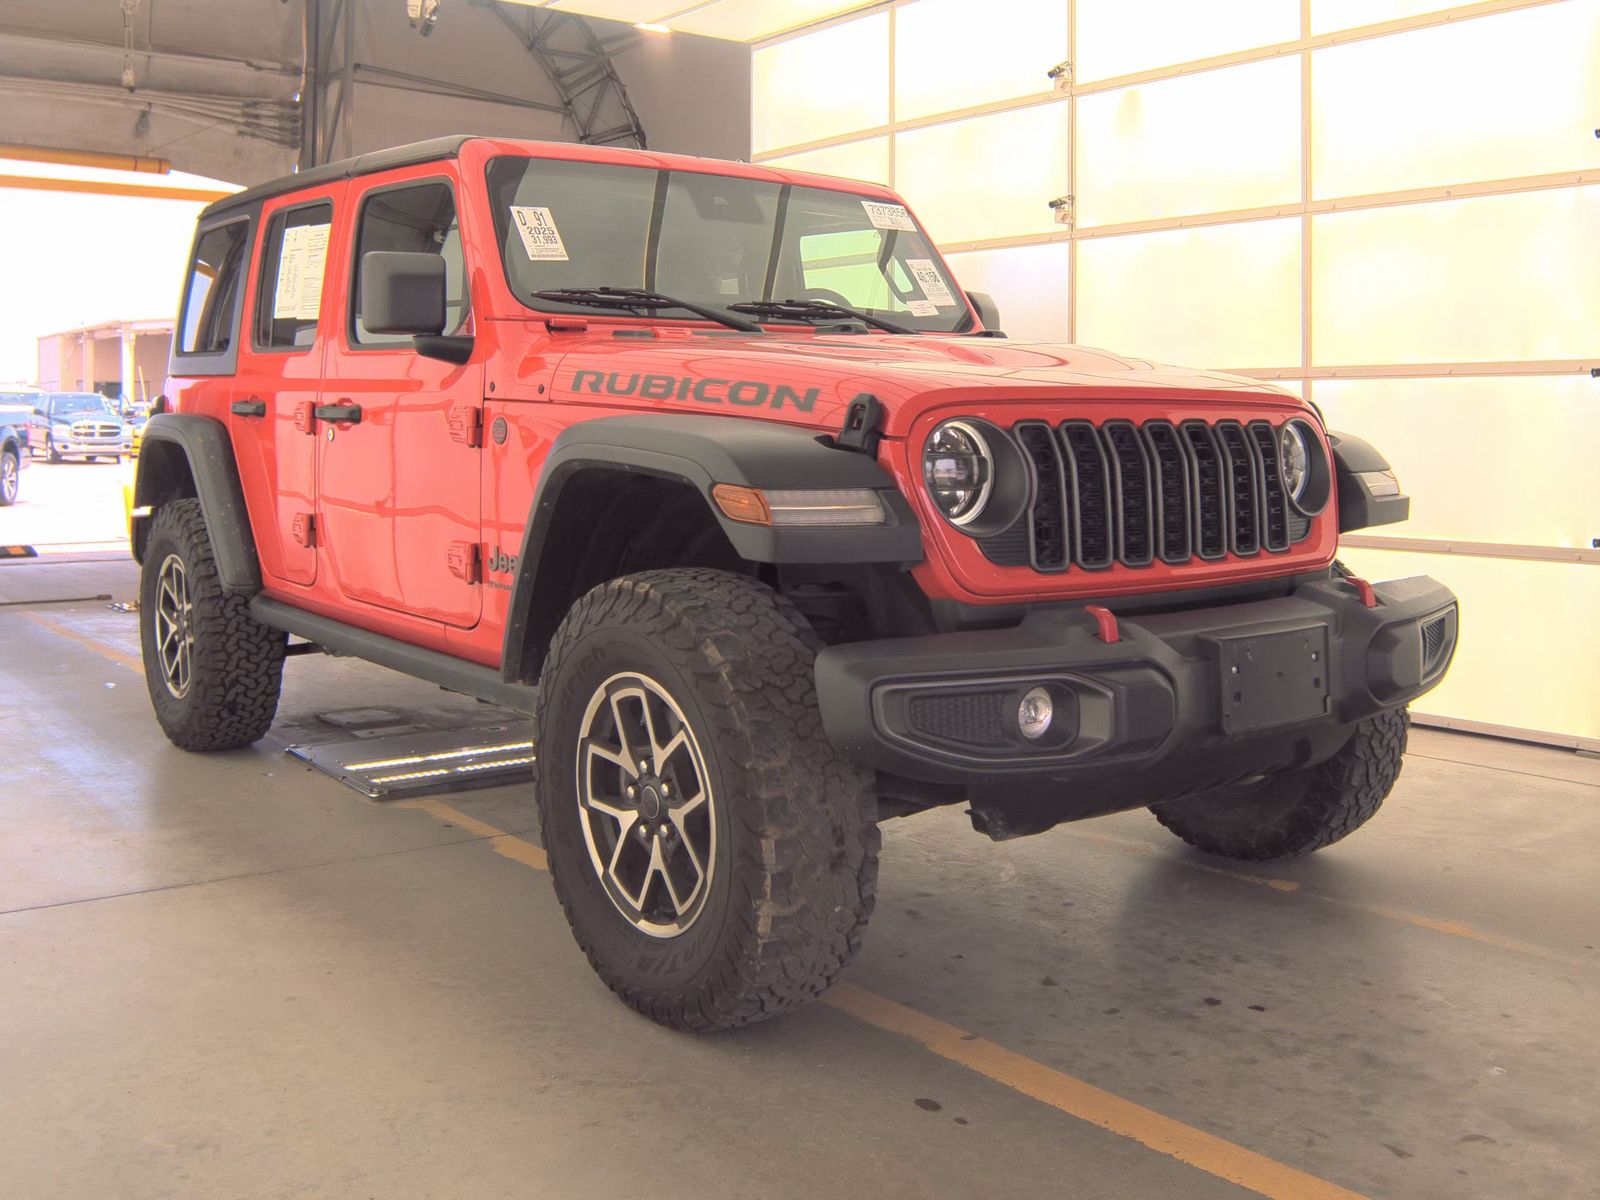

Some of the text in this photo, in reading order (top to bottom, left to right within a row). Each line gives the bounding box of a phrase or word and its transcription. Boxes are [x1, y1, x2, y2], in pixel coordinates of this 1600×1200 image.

[516, 210, 547, 227] D 91
[526, 226, 555, 235] 2025
[530, 235, 558, 245] 31,993
[571, 369, 820, 413] RUBICON
[487, 544, 518, 573] Jee
